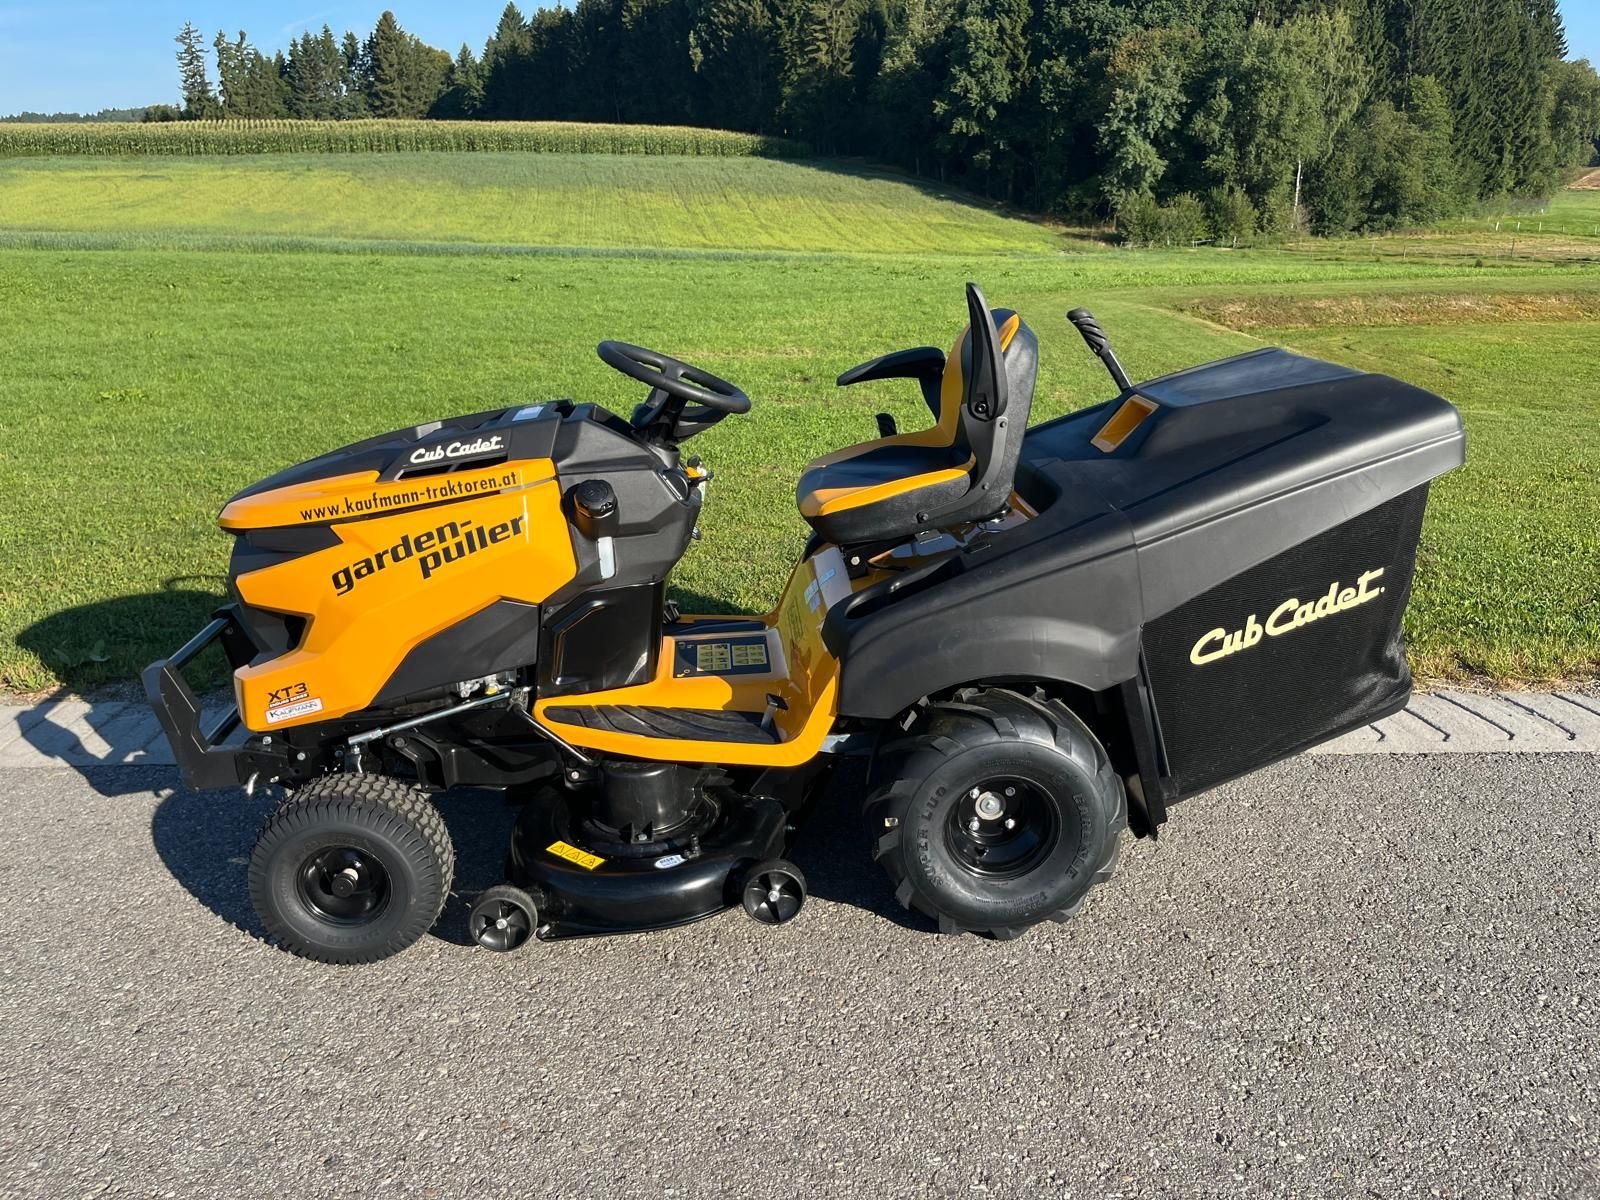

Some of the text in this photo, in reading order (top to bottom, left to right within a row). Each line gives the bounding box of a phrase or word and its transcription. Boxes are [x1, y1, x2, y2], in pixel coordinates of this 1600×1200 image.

[410, 447, 444, 464] Cub
[300, 471, 518, 521] www.kaufmann-traktoren.at
[331, 520, 472, 596] garden-
[418, 514, 526, 580] puller
[1189, 614, 1264, 665] Cub
[267, 682, 307, 703] XT3
